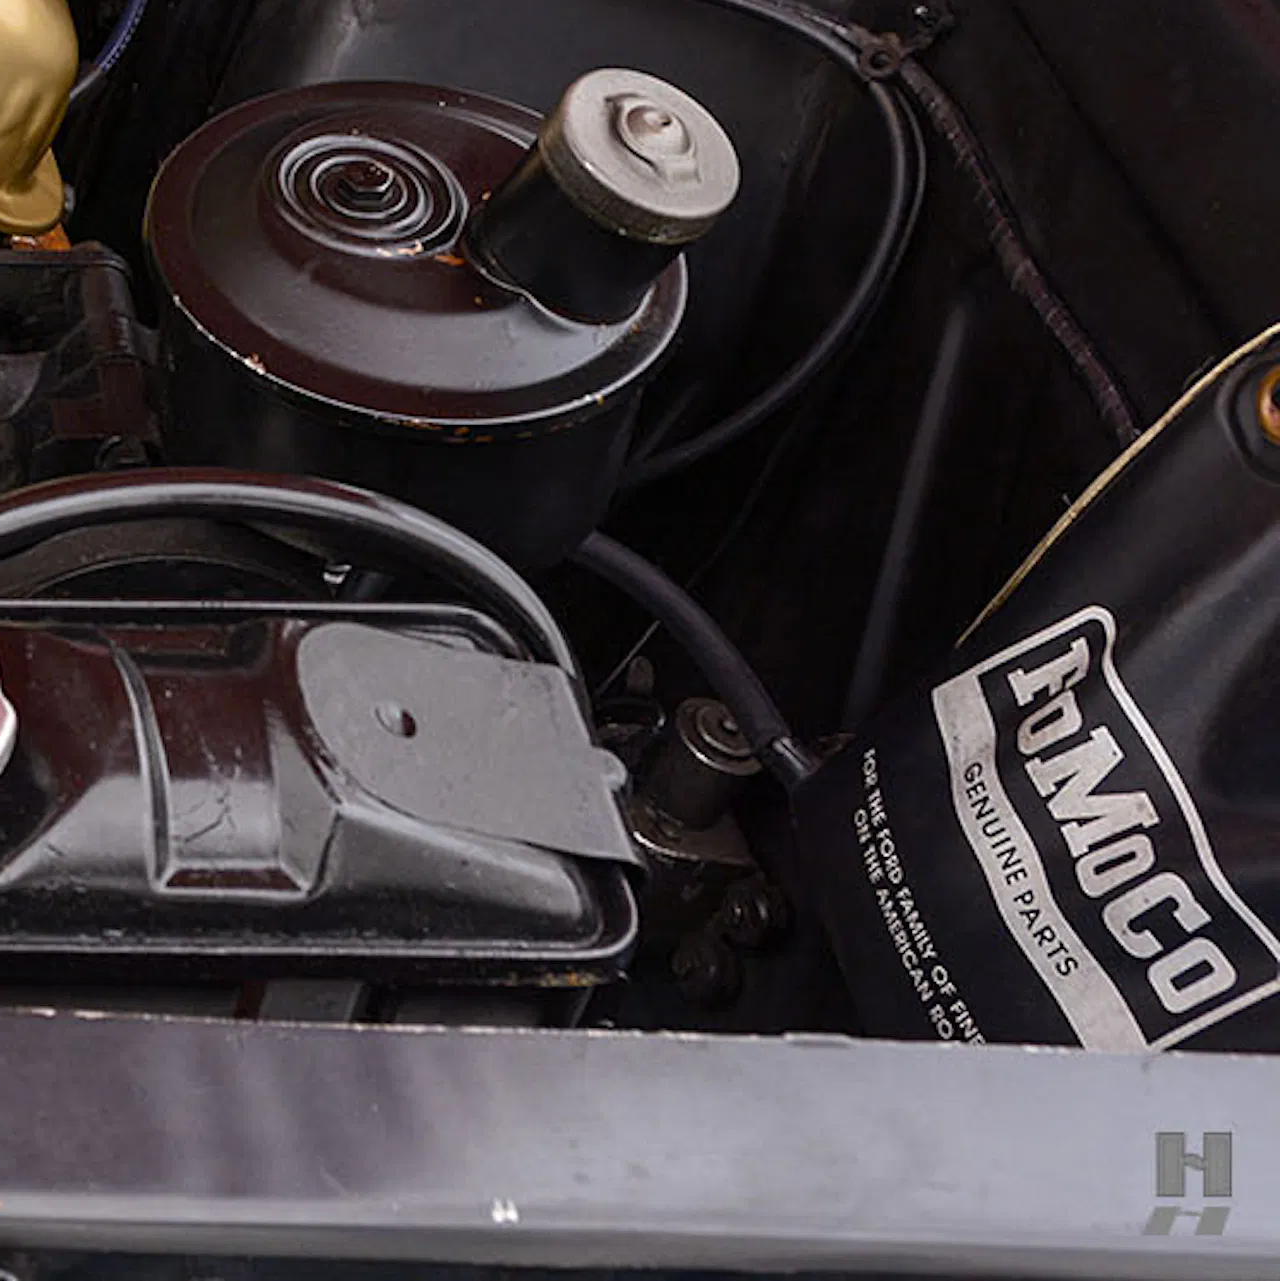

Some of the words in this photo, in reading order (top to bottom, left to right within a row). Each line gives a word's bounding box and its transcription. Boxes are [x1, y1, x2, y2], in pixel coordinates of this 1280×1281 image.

[863, 748, 878, 788] FOR
[868, 788, 887, 826] THE
[876, 828, 904, 884] FORD
[963, 761, 1029, 887] GENUINE
[1013, 882, 1080, 978] PARTS
[854, 808, 871, 844] ON
[864, 843, 884, 883] THE
[876, 888, 934, 1002] AMERICAN
[929, 1004, 954, 1040] RO
[896, 885, 938, 958] FAMILY
[931, 965, 957, 996] OF
